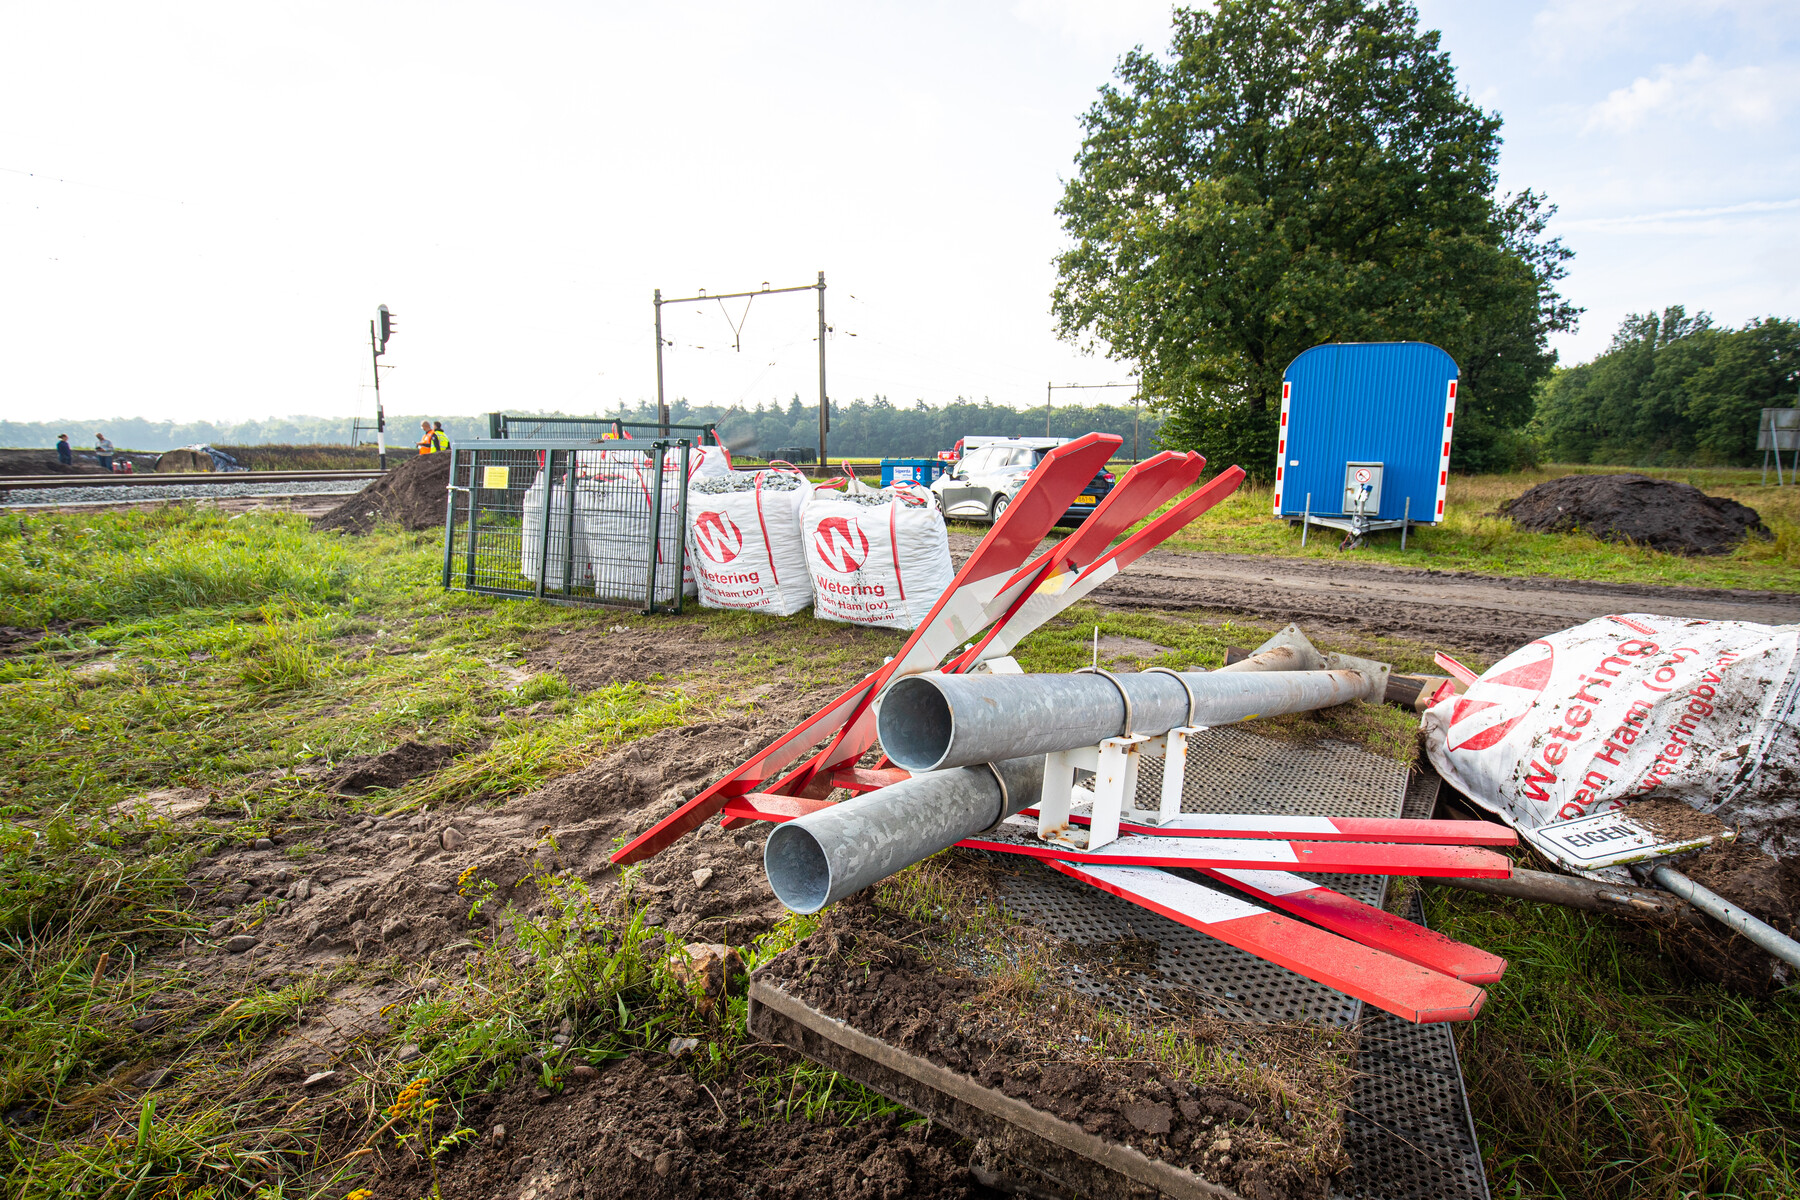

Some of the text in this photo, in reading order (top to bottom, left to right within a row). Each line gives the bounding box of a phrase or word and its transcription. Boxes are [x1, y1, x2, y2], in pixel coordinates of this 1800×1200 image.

[697, 565, 760, 585] Wetering
[816, 574, 886, 598] Wetering
[718, 588, 741, 598] Ham
[742, 586, 764, 598] (ov)
[821, 593, 889, 613] Den Ham (ov)
[1523, 639, 1660, 802] Wetering
[1559, 769, 1609, 820] Den
[1593, 699, 1655, 767] Ham
[1641, 647, 1700, 693] (ov)
[1562, 823, 1638, 848] EIGEN
